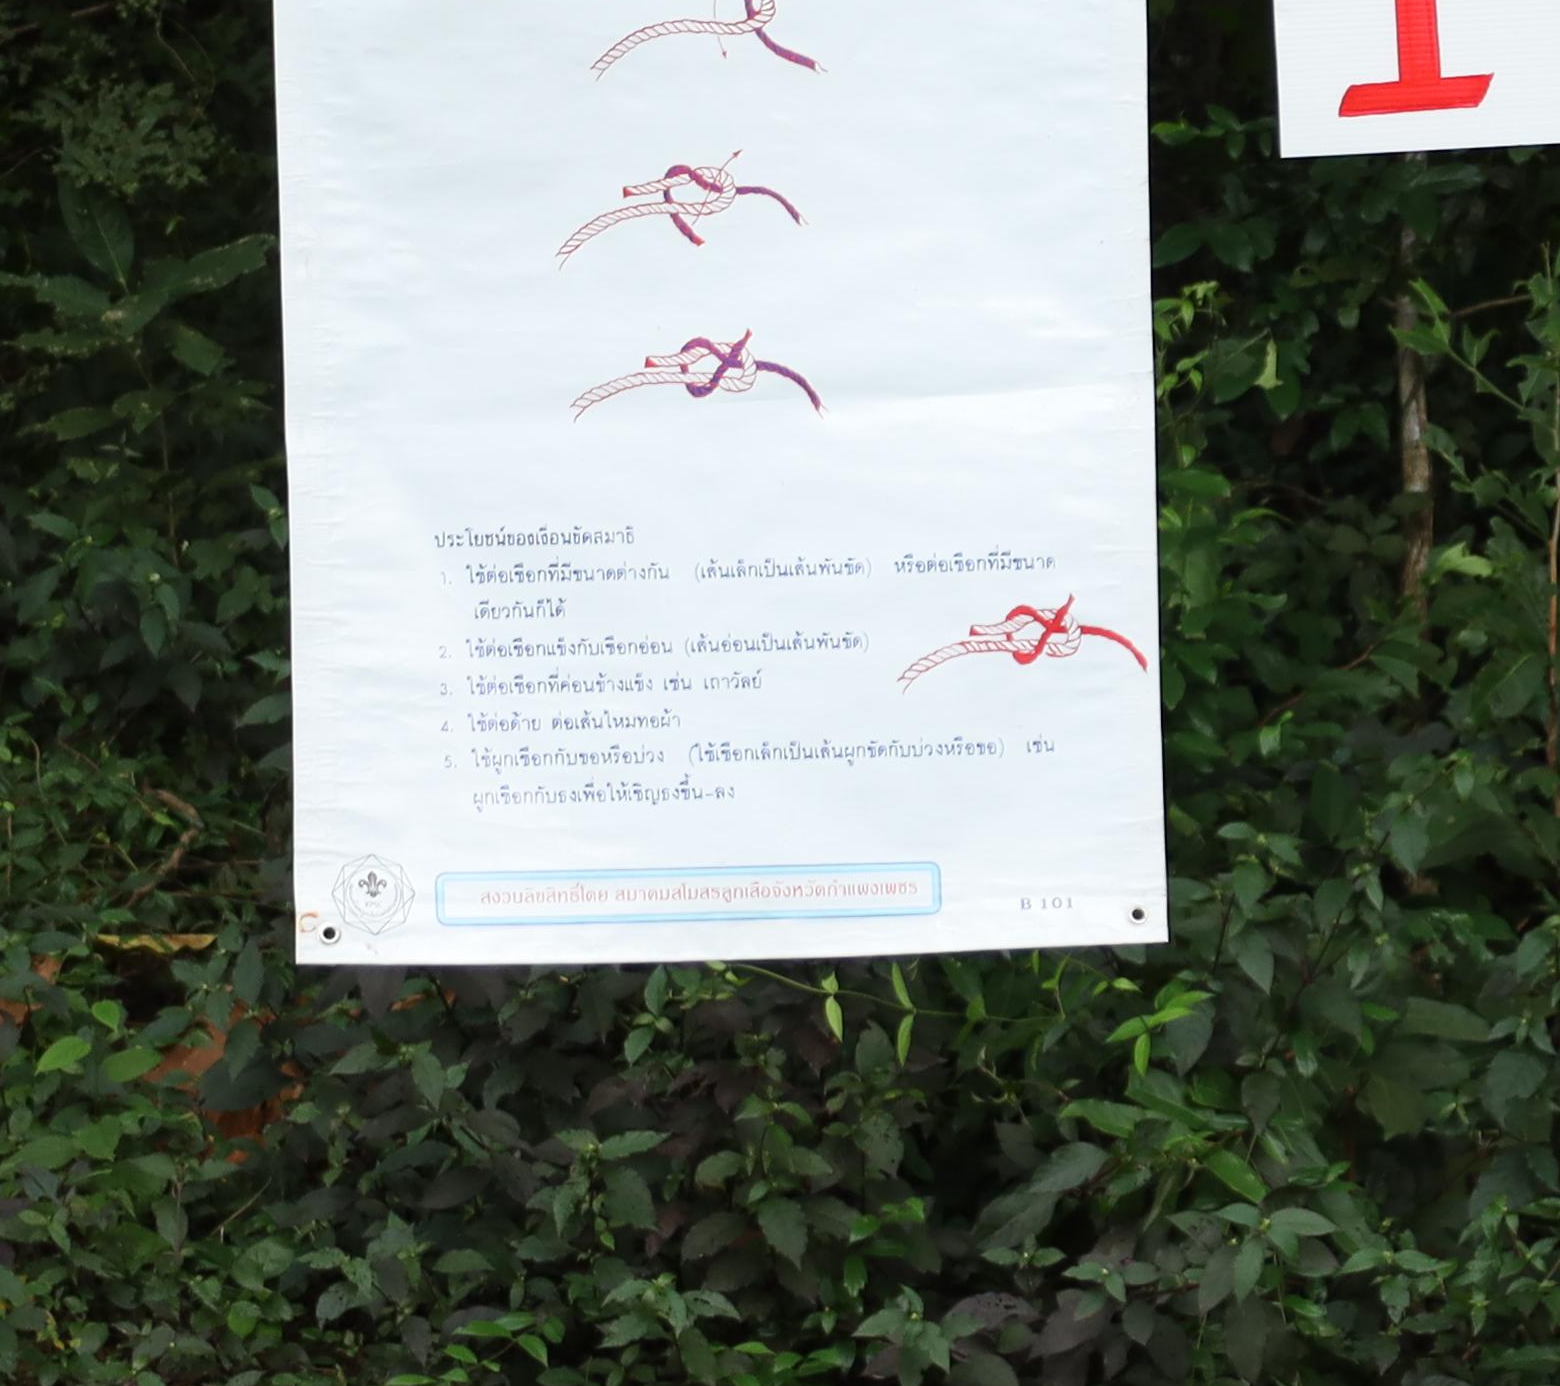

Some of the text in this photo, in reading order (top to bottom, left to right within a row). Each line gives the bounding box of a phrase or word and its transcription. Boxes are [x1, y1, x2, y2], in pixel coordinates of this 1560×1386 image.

[434, 523, 635, 548] ประโยชน์ของเงื่อนขัดสมาธิ
[466, 557, 670, 584] ใช้ต่อเชือกที่มีขนาดต่างกัน
[894, 545, 1056, 574] หรือต่อเชือกที่มีขนาด
[466, 634, 672, 659] ใช้ต่อเชือกแข็งกับเชือกอ่อน
[466, 667, 653, 695] ใช้ต่อเชือกที่ค่อนข้างแข็ง
[663, 671, 692, 691] เช่น
[703, 669, 762, 690] เถาวัลย์
[467, 711, 541, 733] ใช้ต่อด้าย
[1026, 734, 1055, 753] เช่น
[1041, 896, 1073, 910] 101
